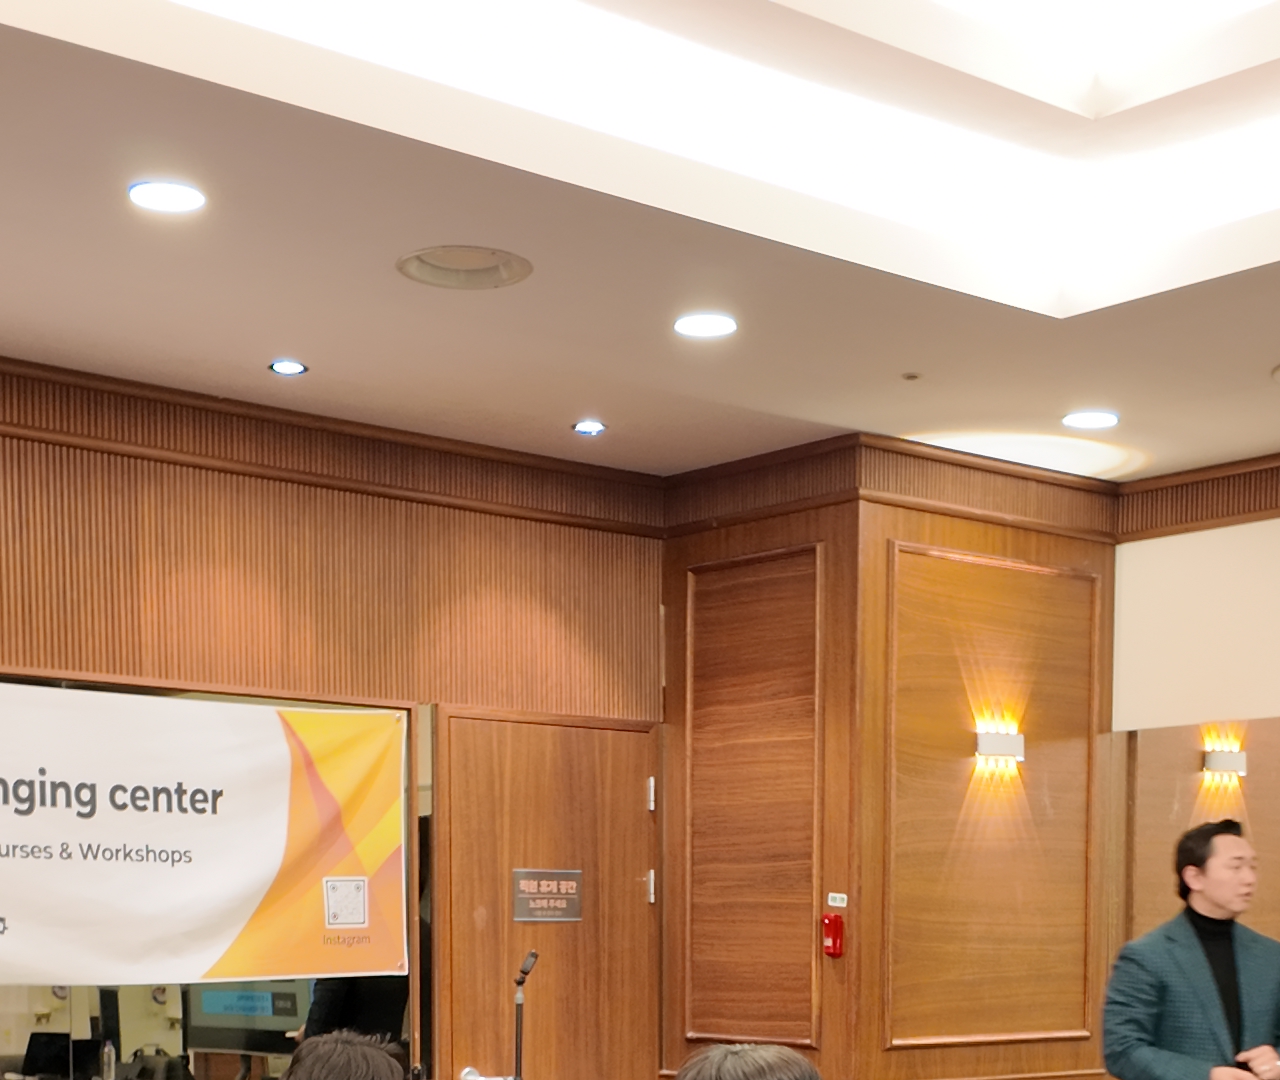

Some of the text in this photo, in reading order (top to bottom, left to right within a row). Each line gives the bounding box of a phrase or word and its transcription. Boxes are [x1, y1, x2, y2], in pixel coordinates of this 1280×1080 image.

[108, 781, 223, 815] center
[59, 843, 73, 860] &
[79, 843, 192, 867] Workshops
[323, 934, 371, 948] Instagram
